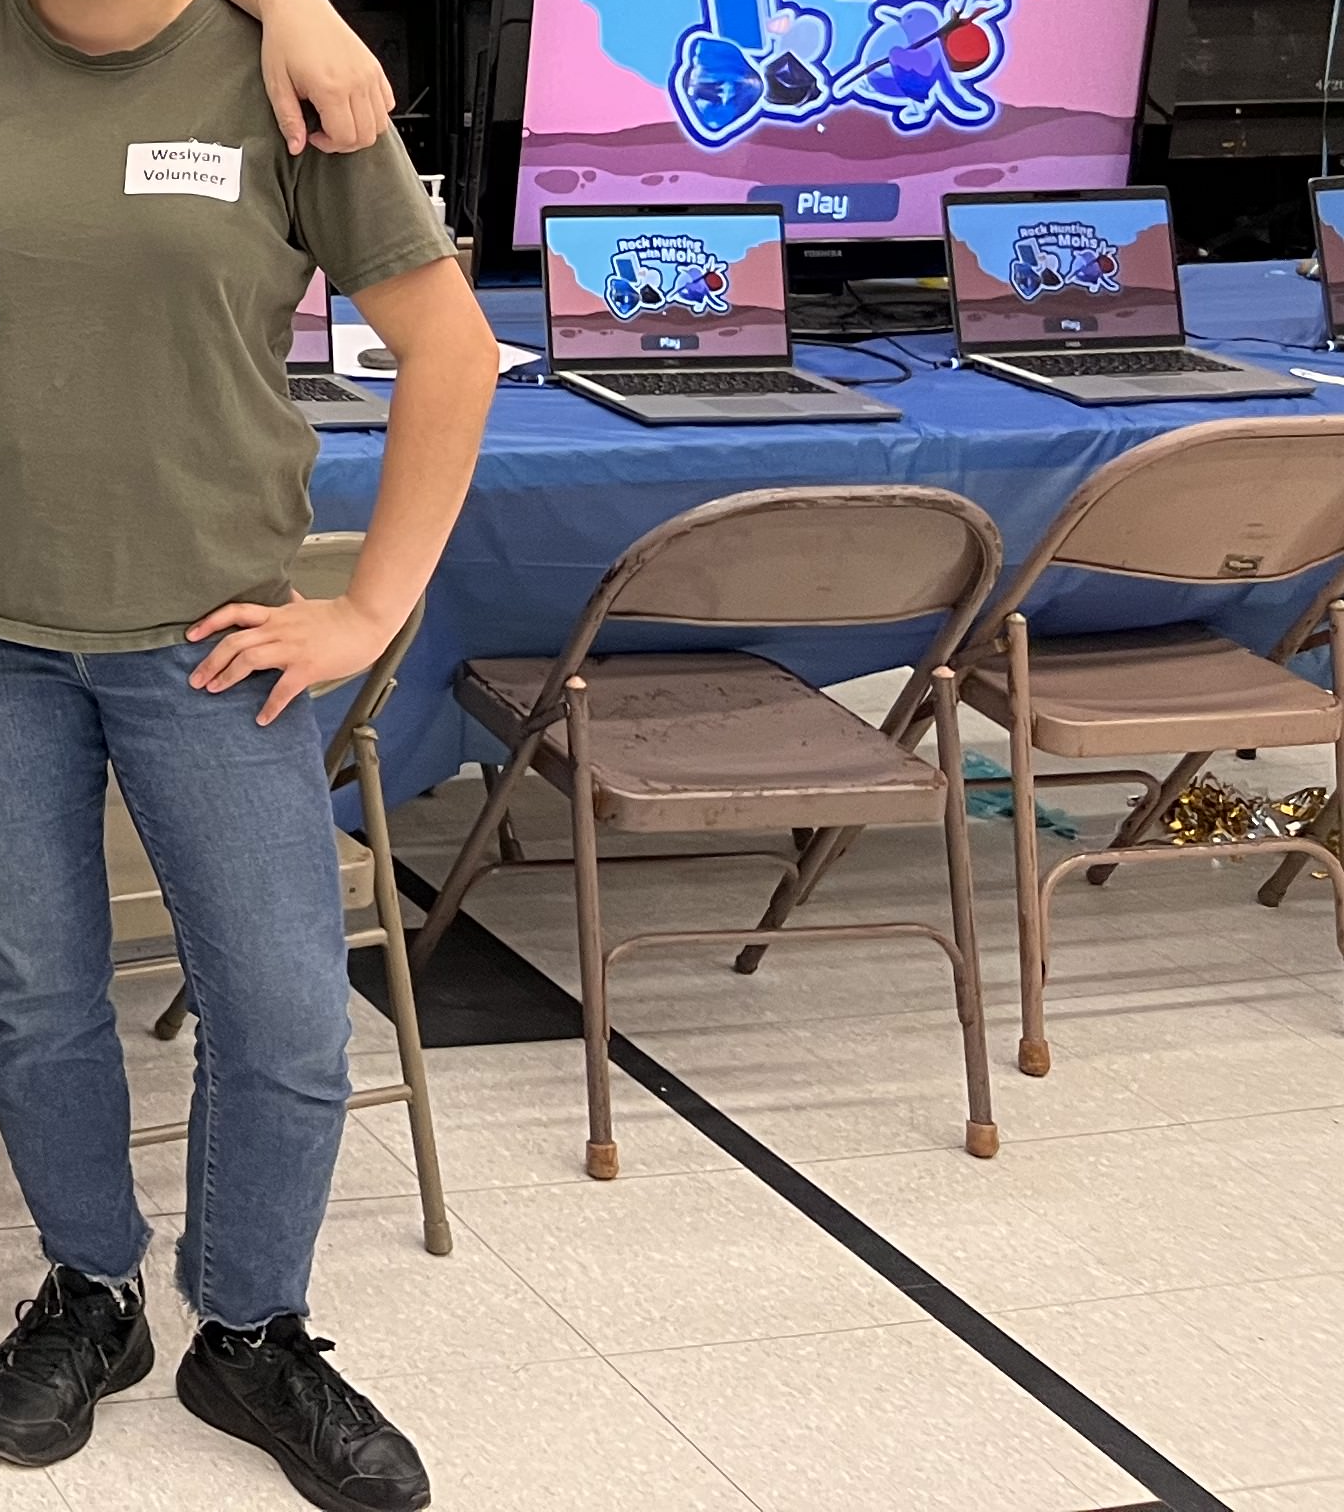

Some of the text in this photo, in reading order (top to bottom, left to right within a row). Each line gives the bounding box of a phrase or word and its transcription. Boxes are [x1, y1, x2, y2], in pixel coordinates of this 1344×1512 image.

[151, 148, 222, 164] Weslyan
[143, 169, 227, 186] Volunteer
[797, 190, 849, 220] Play
[1020, 224, 1094, 238] Rock Hunting
[619, 237, 702, 253] Rock Hunting
[1058, 234, 1098, 249] Mohs
[661, 248, 706, 264] Mohs
